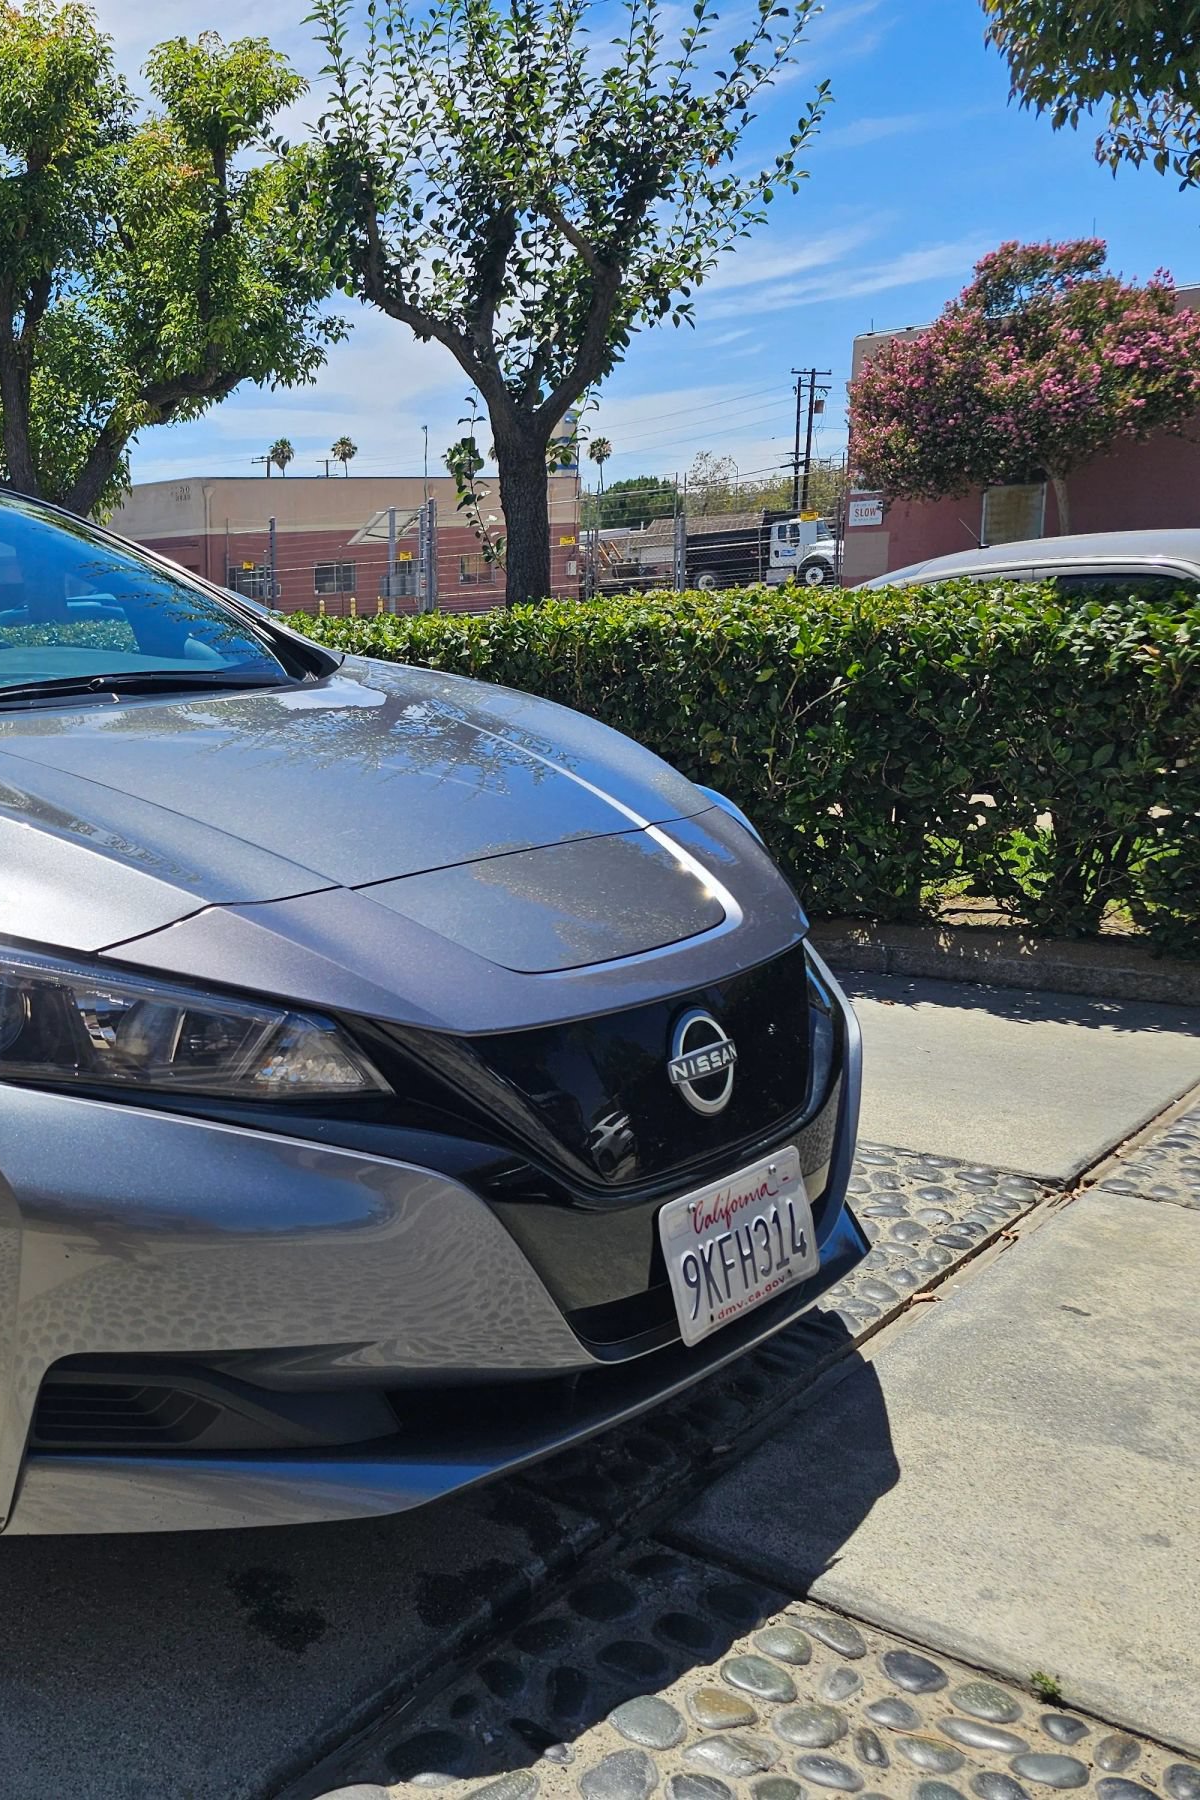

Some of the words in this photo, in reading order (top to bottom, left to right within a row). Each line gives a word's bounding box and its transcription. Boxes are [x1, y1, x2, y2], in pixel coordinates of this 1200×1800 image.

[854, 507, 877, 518] SLOW
[670, 1042, 738, 1081] NISSAN
[691, 1178, 780, 1235] California
[680, 1198, 808, 1321] 9KFH314
[717, 1275, 786, 1320] dmv.ca.gov
